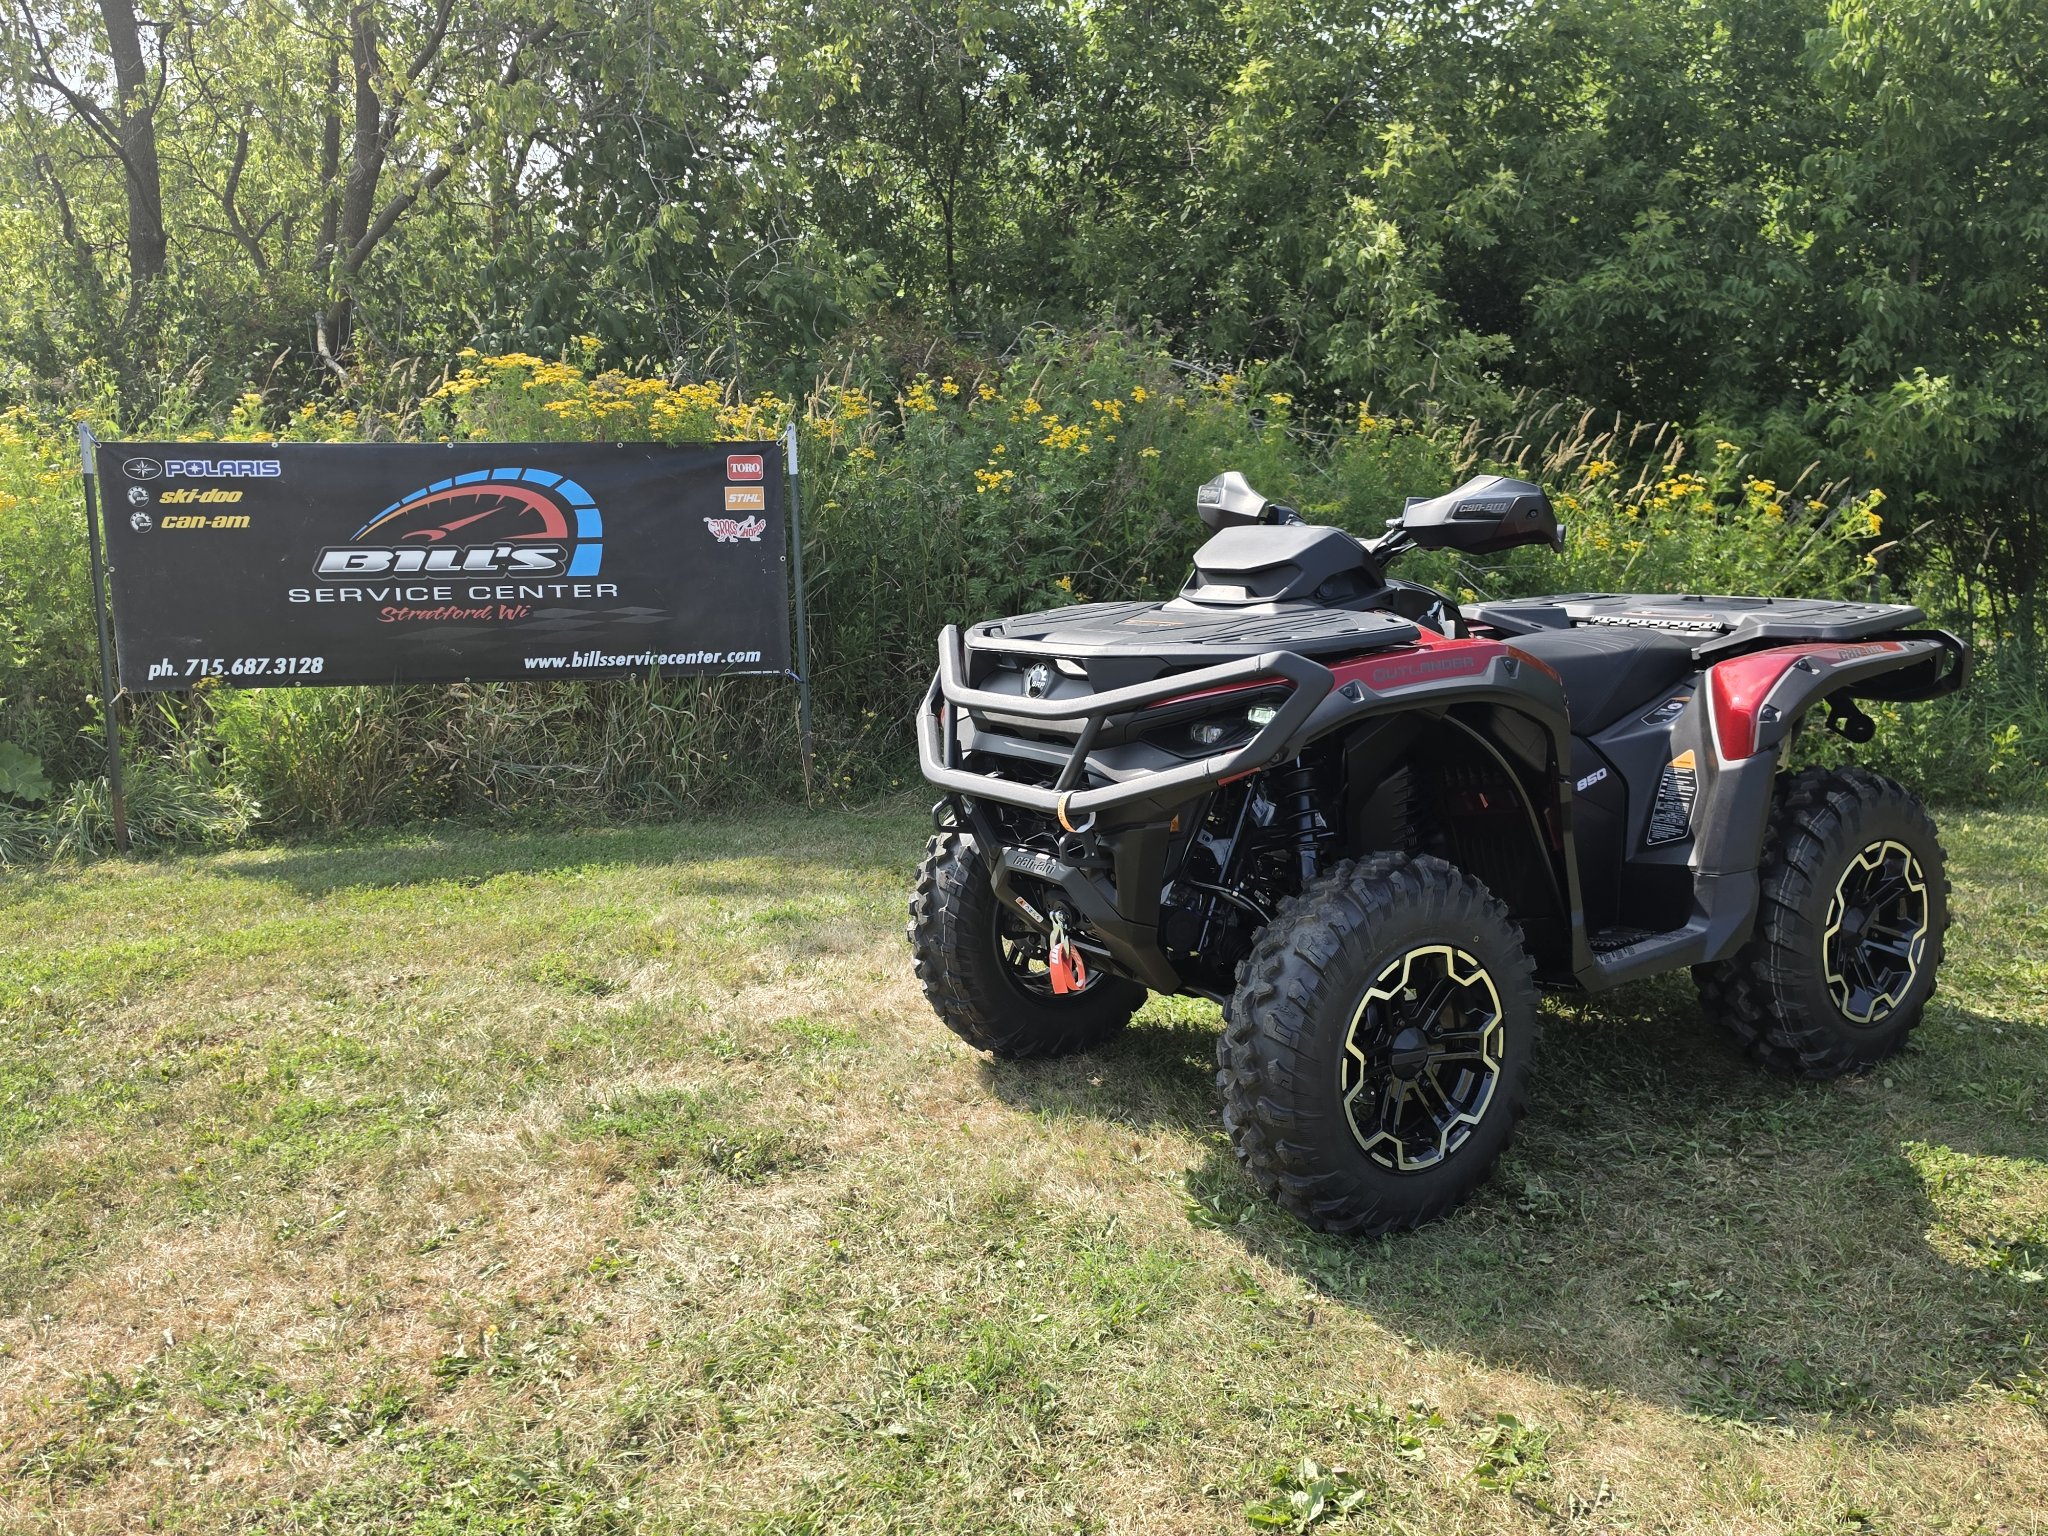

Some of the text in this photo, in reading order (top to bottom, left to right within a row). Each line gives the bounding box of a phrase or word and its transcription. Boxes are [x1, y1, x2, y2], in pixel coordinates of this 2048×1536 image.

[165, 460, 282, 478] POLARIS
[730, 462, 761, 473] TORO
[159, 488, 244, 504] ski-doo
[728, 493, 761, 503] STIHL
[1459, 502, 1507, 513] can-am
[161, 514, 251, 529] can-am
[317, 546, 560, 573] BILL'S
[288, 583, 618, 603] SERVICE CENTER
[376, 604, 532, 623] Stratford, Wi
[148, 656, 324, 681] ph. 715.687.3128
[523, 650, 762, 669] www.billsservicecenter.com
[1372, 656, 1475, 683] OUTLANDER
[1577, 767, 1608, 792] 850
[1012, 855, 1057, 875] can-am
